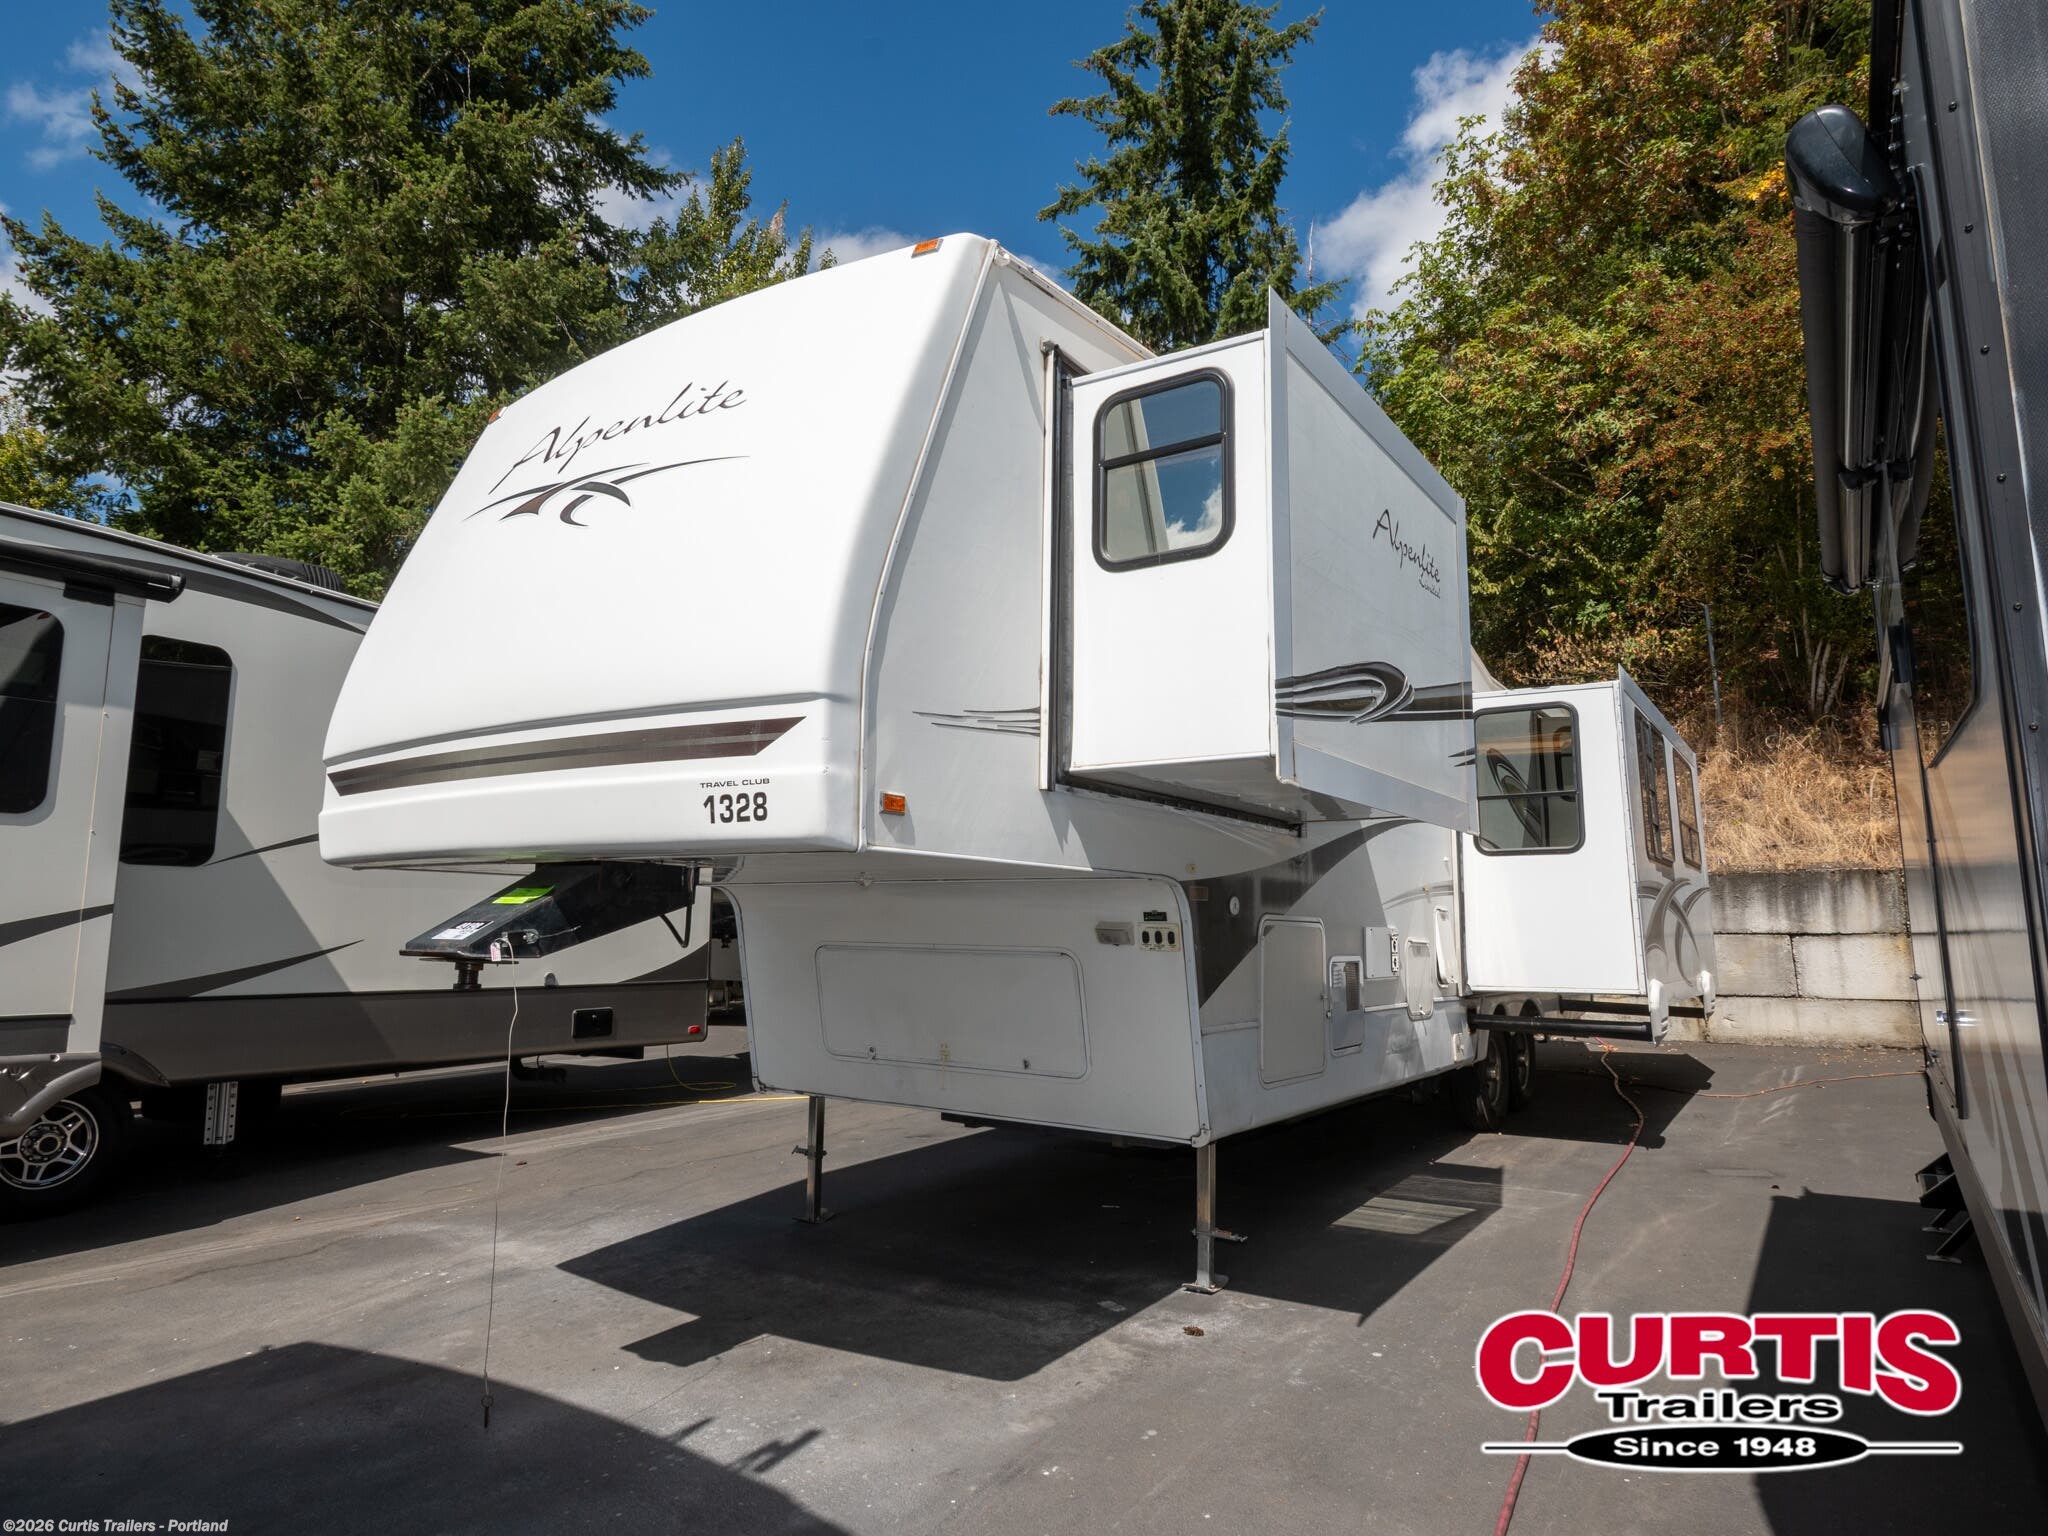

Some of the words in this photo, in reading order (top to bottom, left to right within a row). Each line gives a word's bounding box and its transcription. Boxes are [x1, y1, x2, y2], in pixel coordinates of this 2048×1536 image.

[488, 380, 747, 495] Alpenlite
[1372, 508, 1441, 582] Alpenlite
[700, 780, 738, 788] TRAVEL
[741, 778, 770, 786] CLUB
[703, 791, 768, 824] 1328
